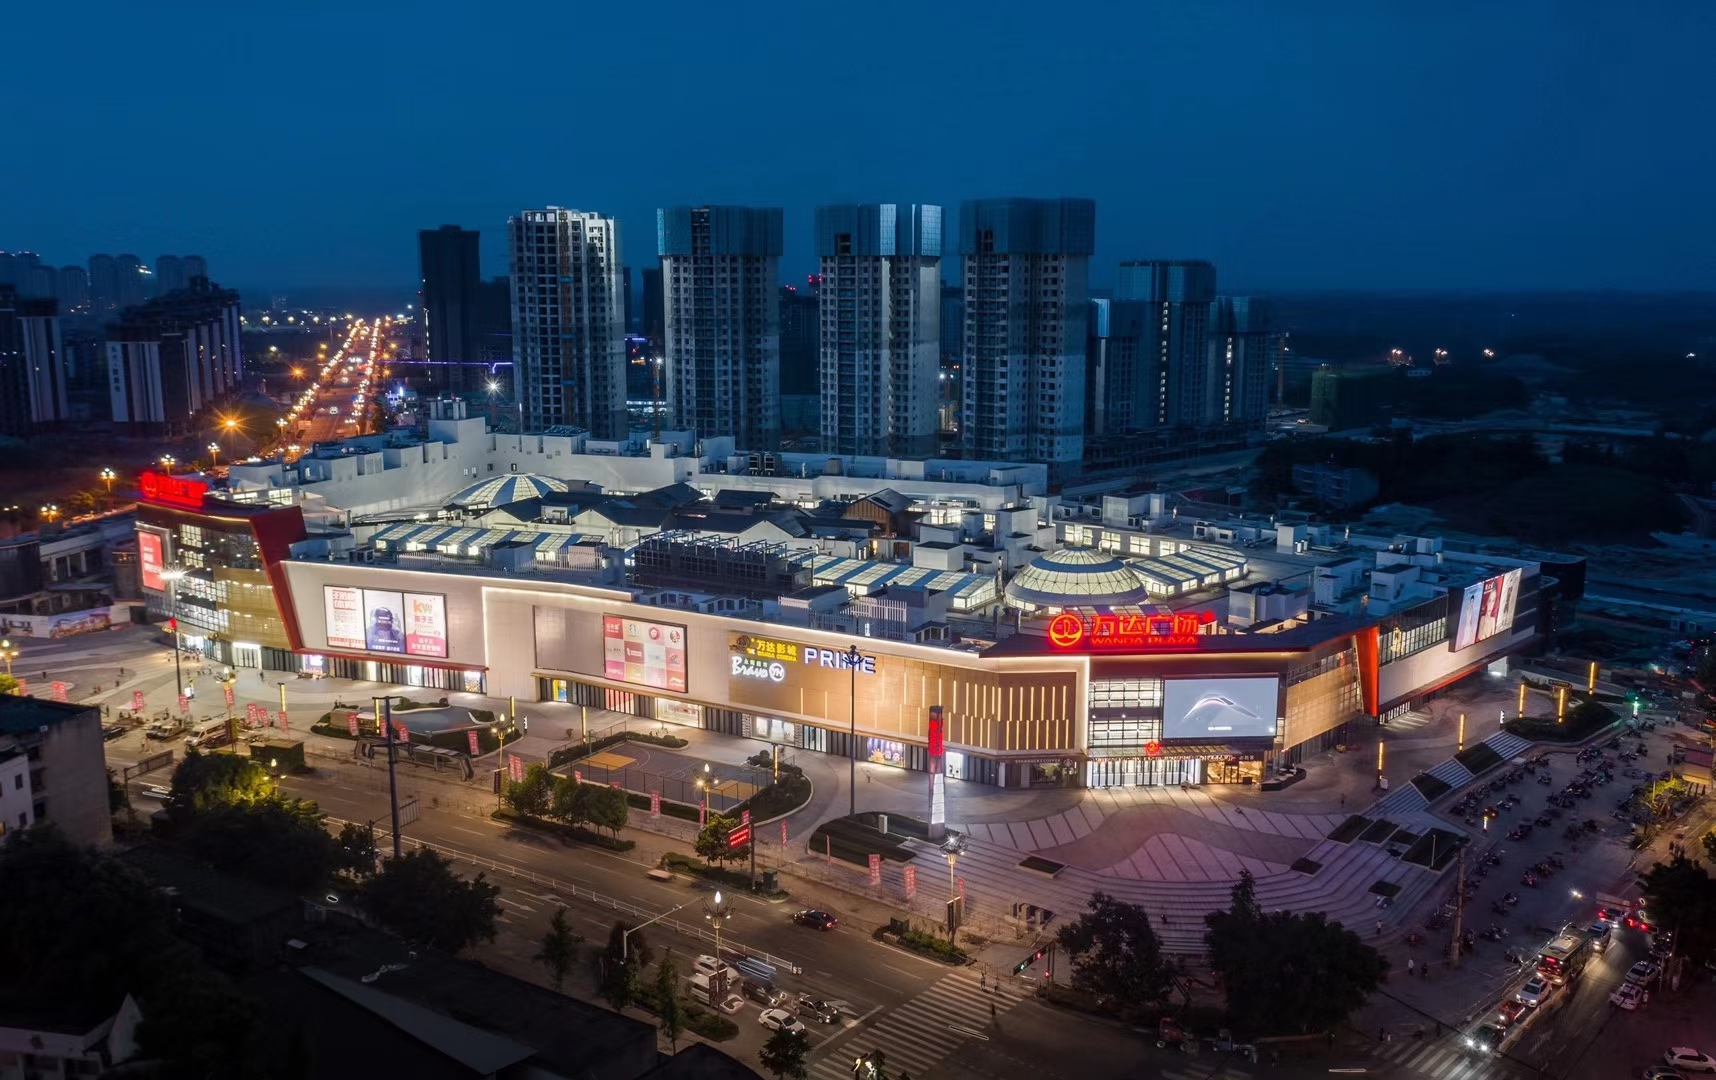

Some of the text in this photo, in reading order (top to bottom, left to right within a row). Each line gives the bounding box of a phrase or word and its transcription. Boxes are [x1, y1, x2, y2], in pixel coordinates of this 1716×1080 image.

[1091, 613, 1198, 635] 万达广场
[756, 639, 797, 656] 万达影城
[1091, 636, 1196, 645] WANDA PLAZA
[732, 655, 769, 678] Bravo
[804, 646, 877, 674] PRIME
